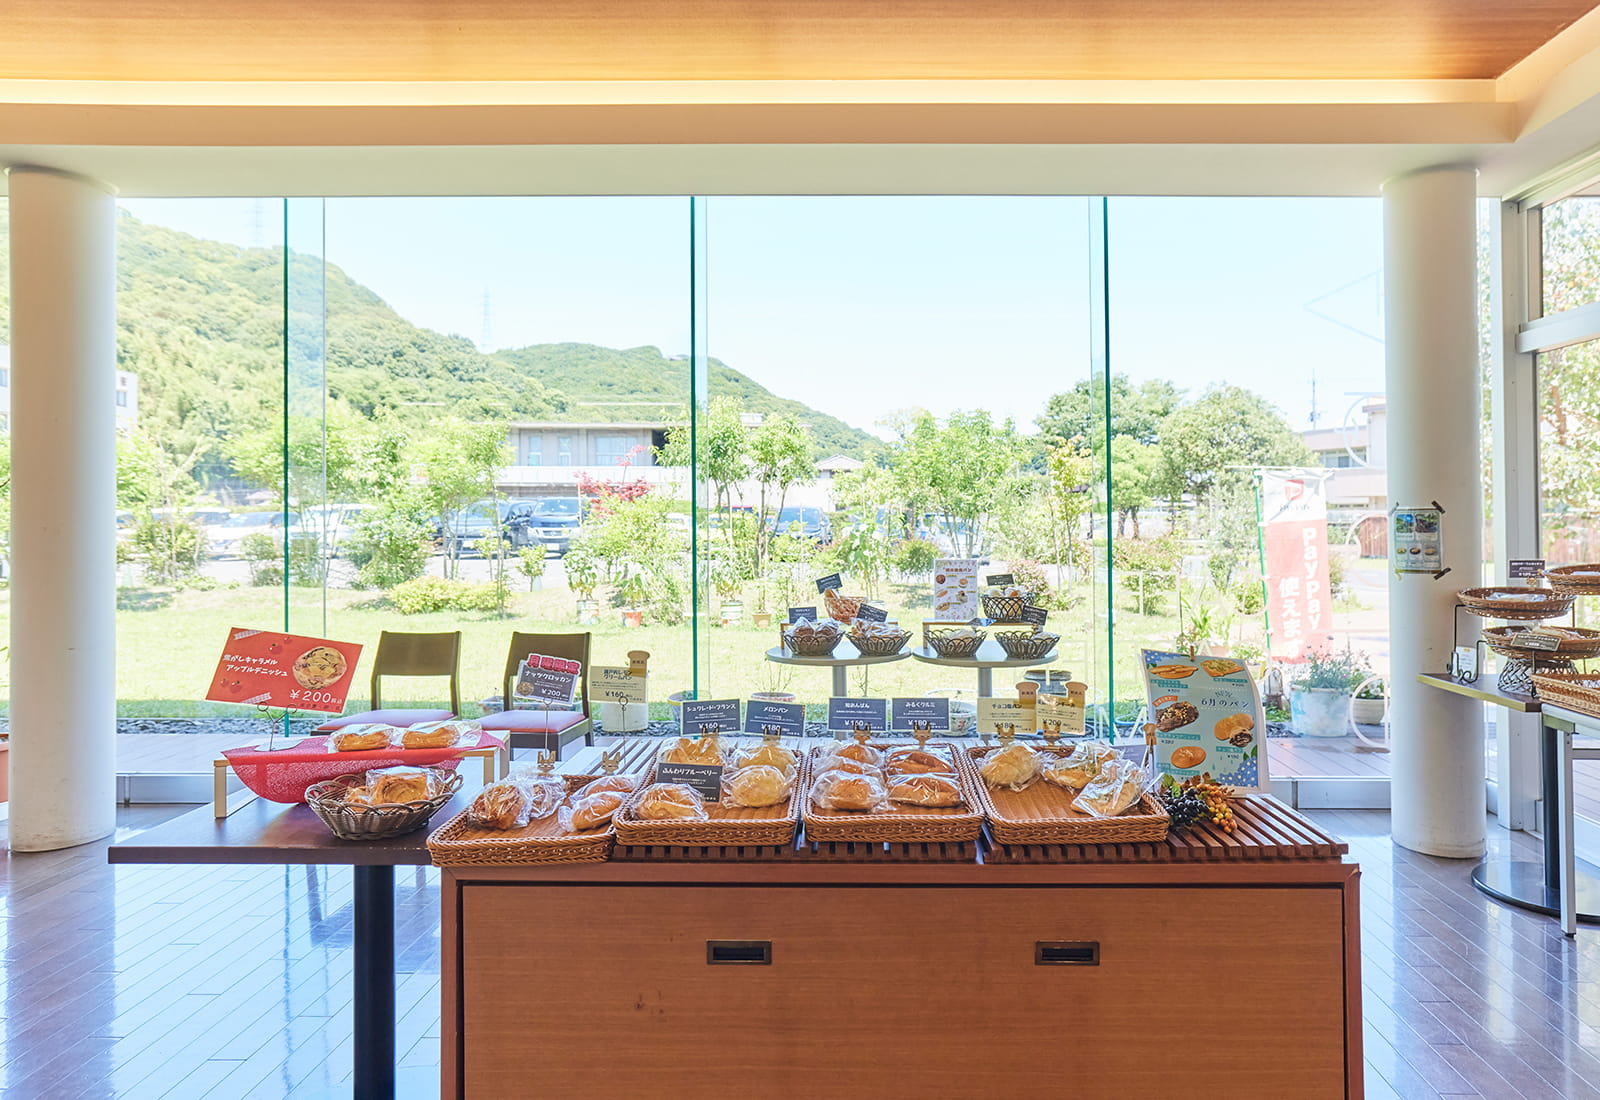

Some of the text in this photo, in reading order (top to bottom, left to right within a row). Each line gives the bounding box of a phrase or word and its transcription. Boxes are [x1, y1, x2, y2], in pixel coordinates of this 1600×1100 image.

[1302, 527, 1321, 631] PayPay
[1279, 576, 1304, 658] 使えます
[226, 664, 289, 677] アップルデニッシュ
[1201, 698, 1249, 709] 6月のパン
[763, 706, 789, 714] メロンパン
[662, 767, 718, 776] ふんわりブルーベリー
